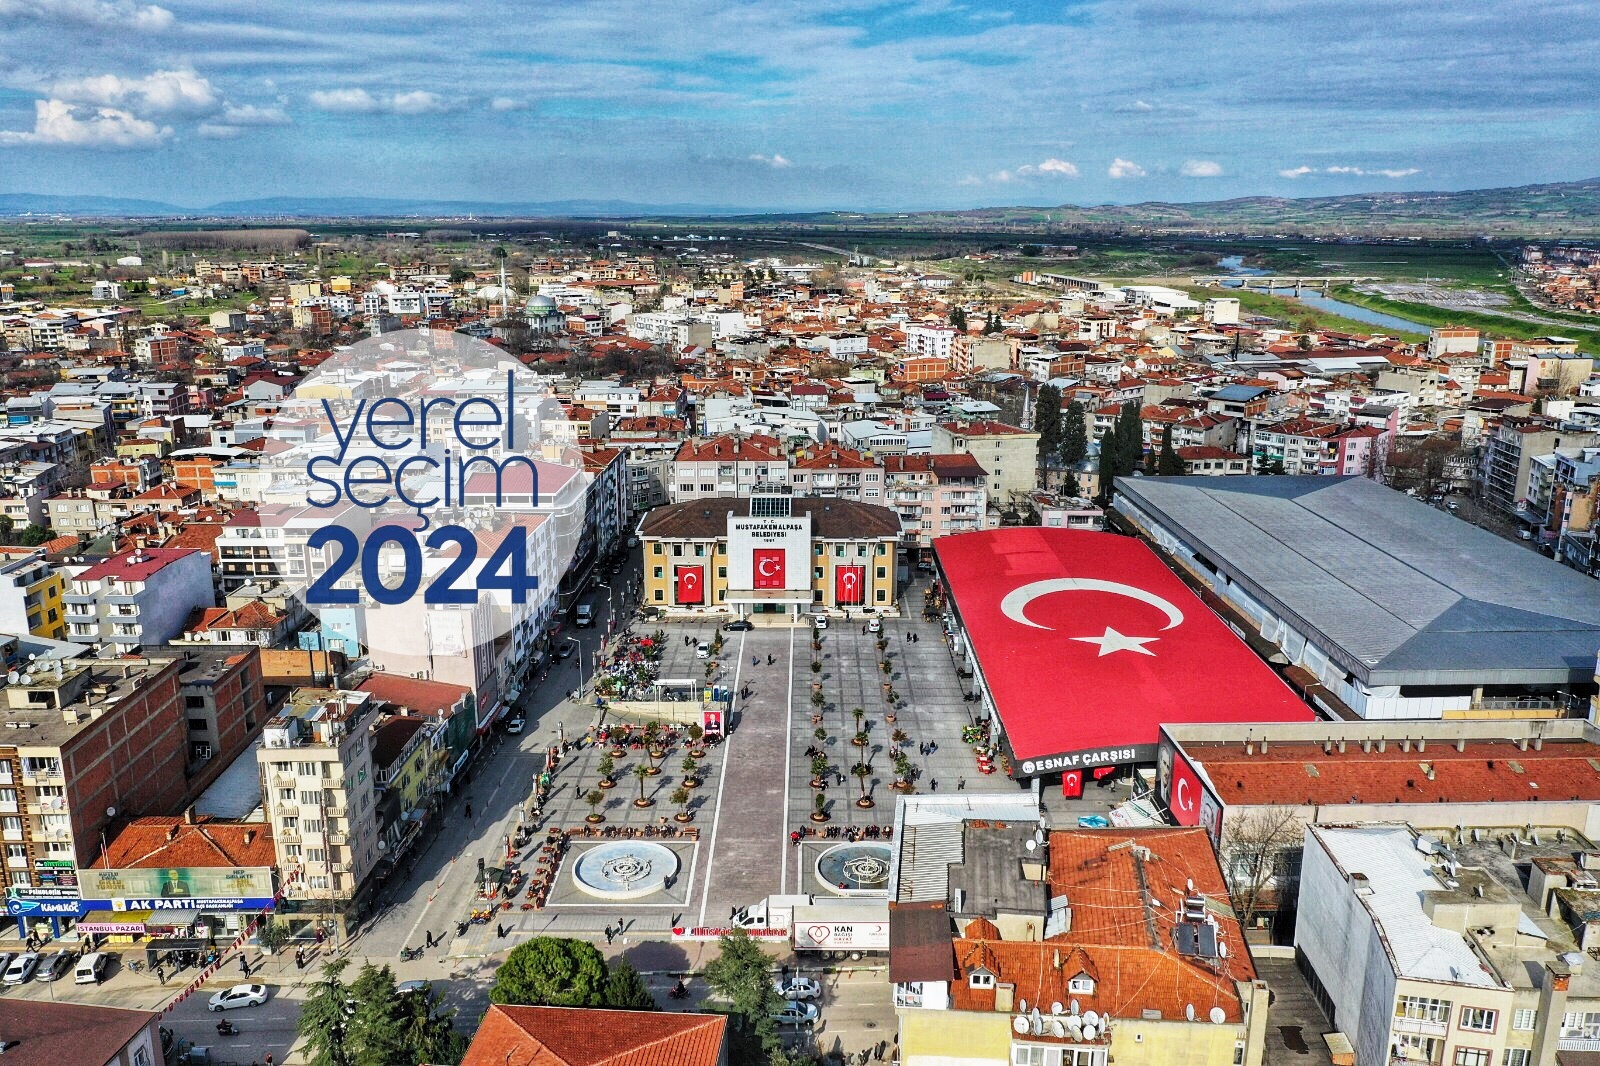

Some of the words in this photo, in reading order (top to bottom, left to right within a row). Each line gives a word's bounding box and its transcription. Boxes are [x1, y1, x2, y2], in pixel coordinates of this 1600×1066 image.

[1035, 754, 1080, 771] ESNAF
[1082, 748, 1136, 766] ÇARŞISI
[130, 900, 152, 910] AK
[834, 925, 853, 933] KAN
